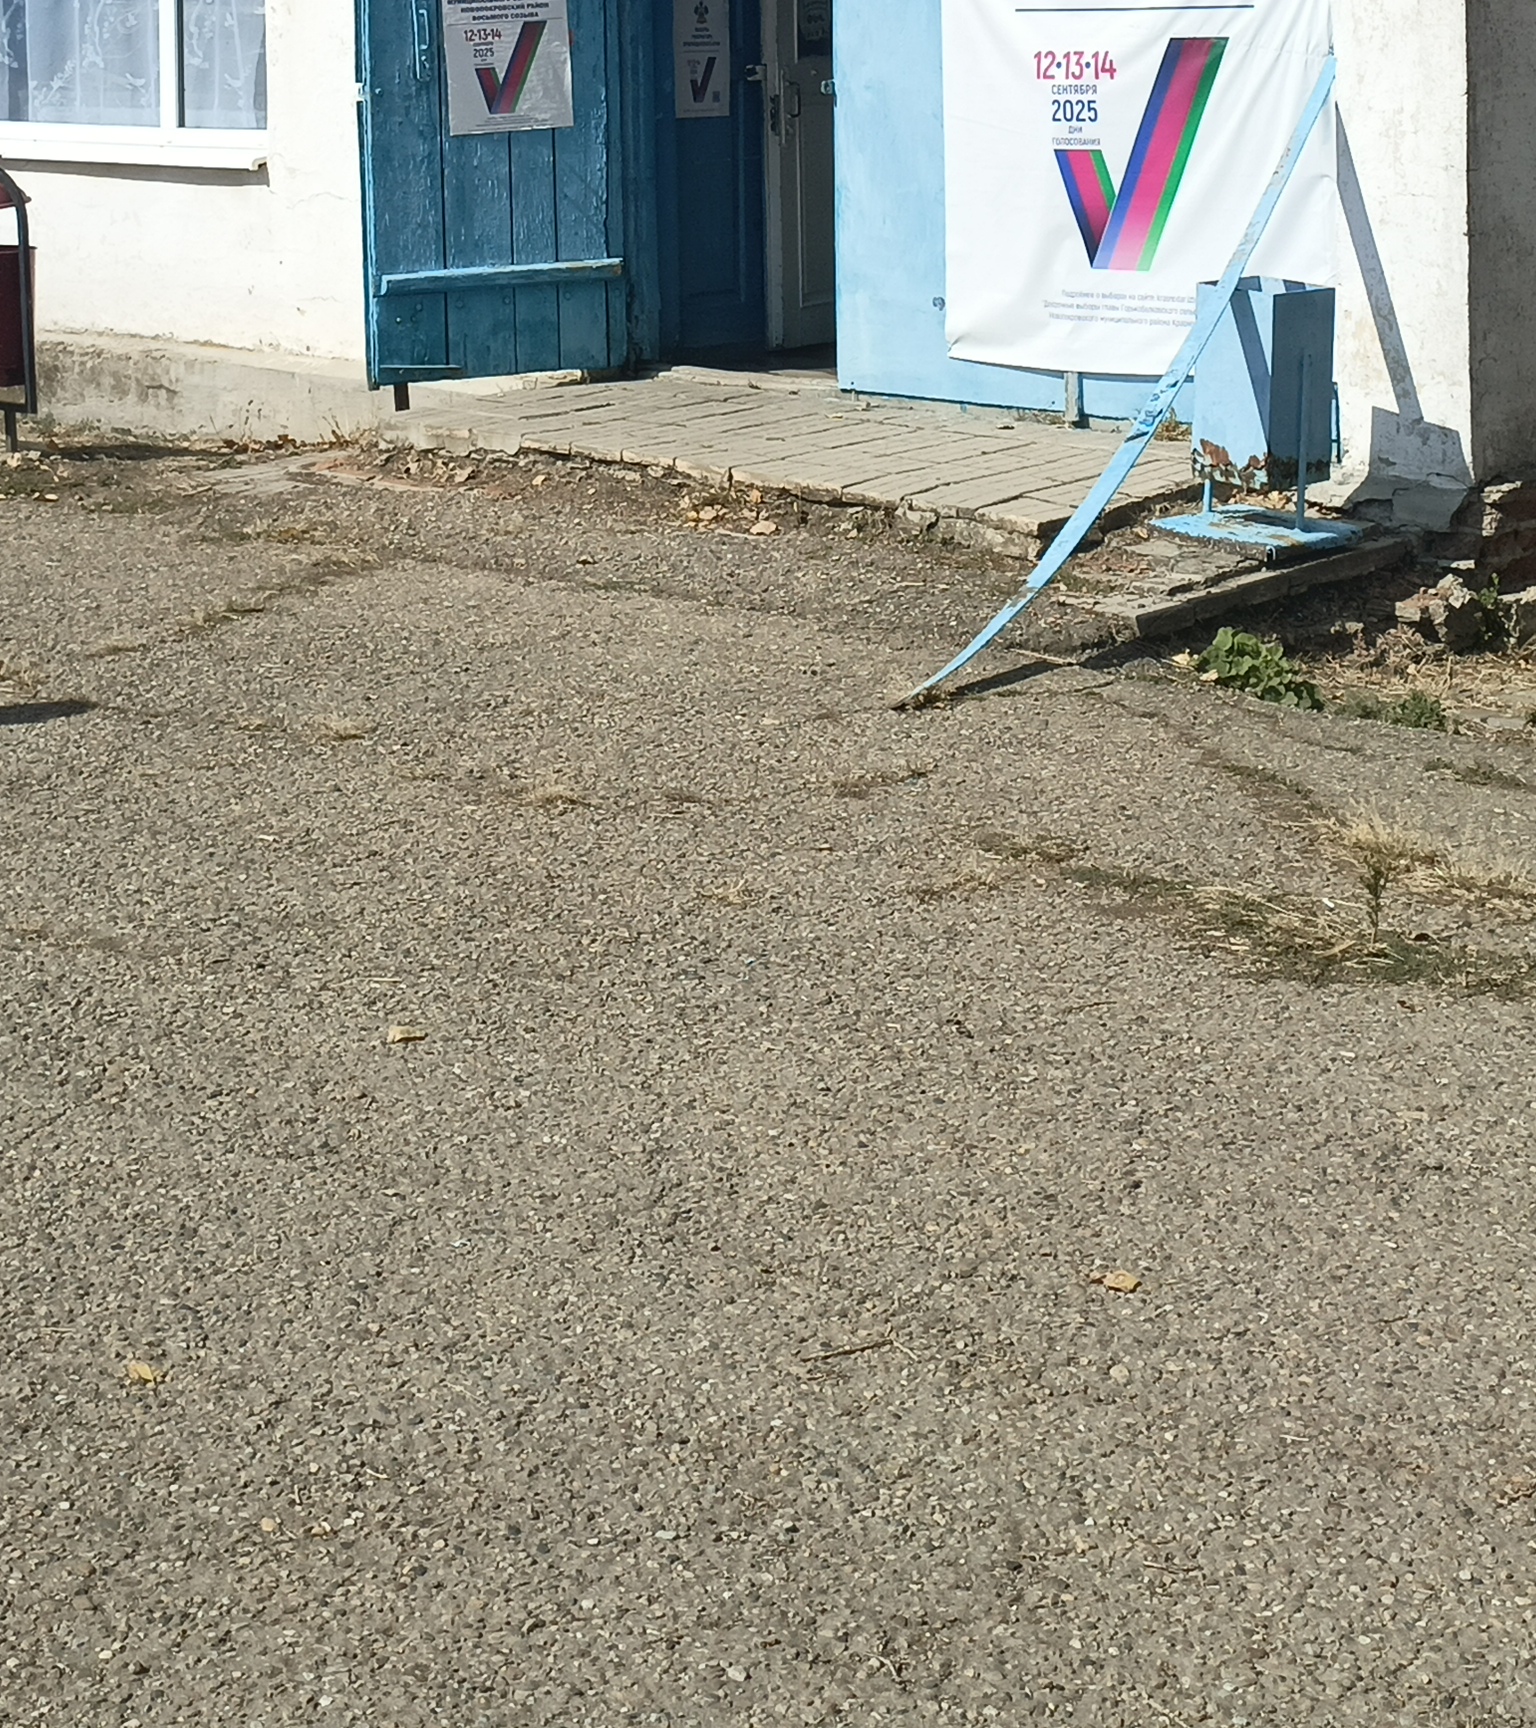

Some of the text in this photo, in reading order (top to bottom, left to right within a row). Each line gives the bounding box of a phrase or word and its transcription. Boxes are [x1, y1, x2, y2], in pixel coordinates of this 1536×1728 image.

[473, 47, 495, 58] 2025
[1052, 84, 1098, 95] СЕНТЯБРЯ
[1052, 99, 1098, 122] 2025
[1068, 125, 1083, 134] ДНИ
[1052, 137, 1101, 146] ГОЛОСОВАНИЯ
